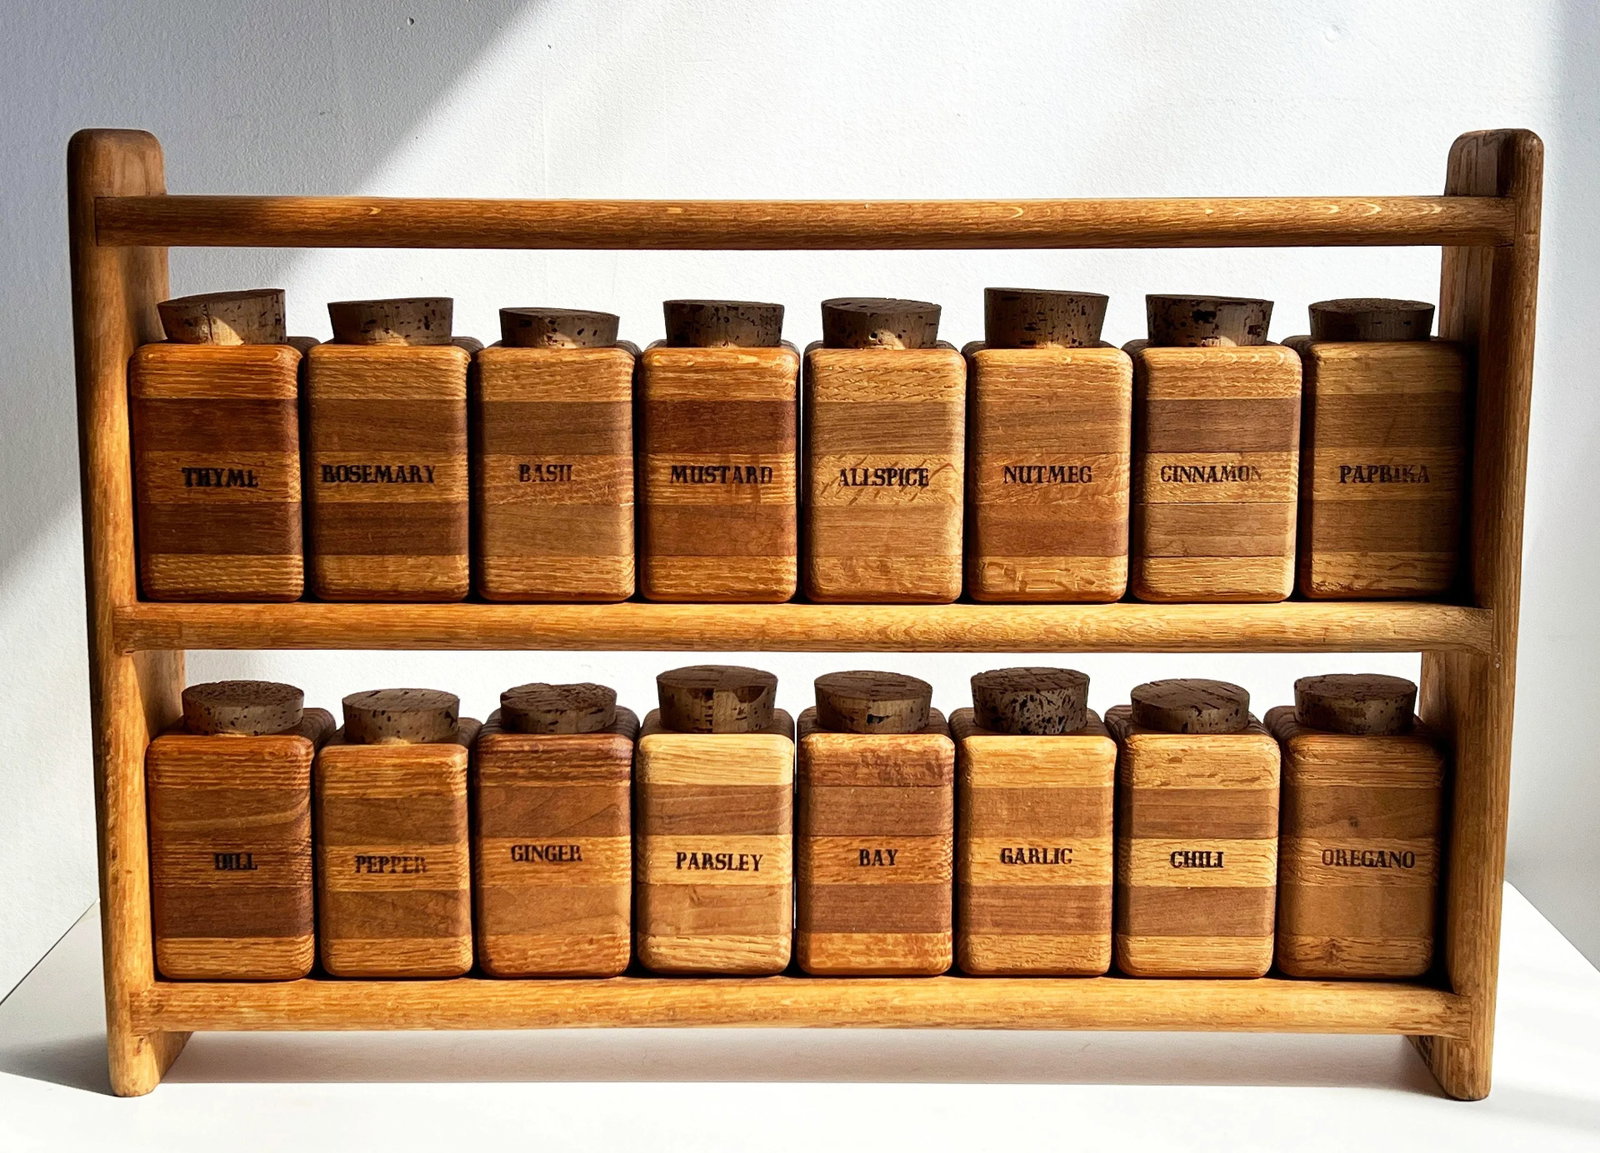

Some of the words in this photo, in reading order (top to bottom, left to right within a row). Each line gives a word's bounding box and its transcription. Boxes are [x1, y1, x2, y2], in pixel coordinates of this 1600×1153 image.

[321, 464, 436, 484] ROSEMARY
[669, 465, 773, 484] MUSTARD
[838, 467, 930, 487] ALLSPICE
[1003, 465, 1093, 484] NUTMEG
[1160, 465, 1263, 483] CINNAMON
[1339, 465, 1431, 484] PAPRIKA
[213, 852, 258, 871] DILL
[511, 844, 583, 863] GINGER
[675, 851, 764, 872] PARSLEY
[858, 848, 899, 867] BAY
[1000, 847, 1074, 865] GARLIC
[1169, 850, 1224, 869] CHILI
[1321, 848, 1416, 869] OREGANO
[354, 855, 428, 874] PEPPER
